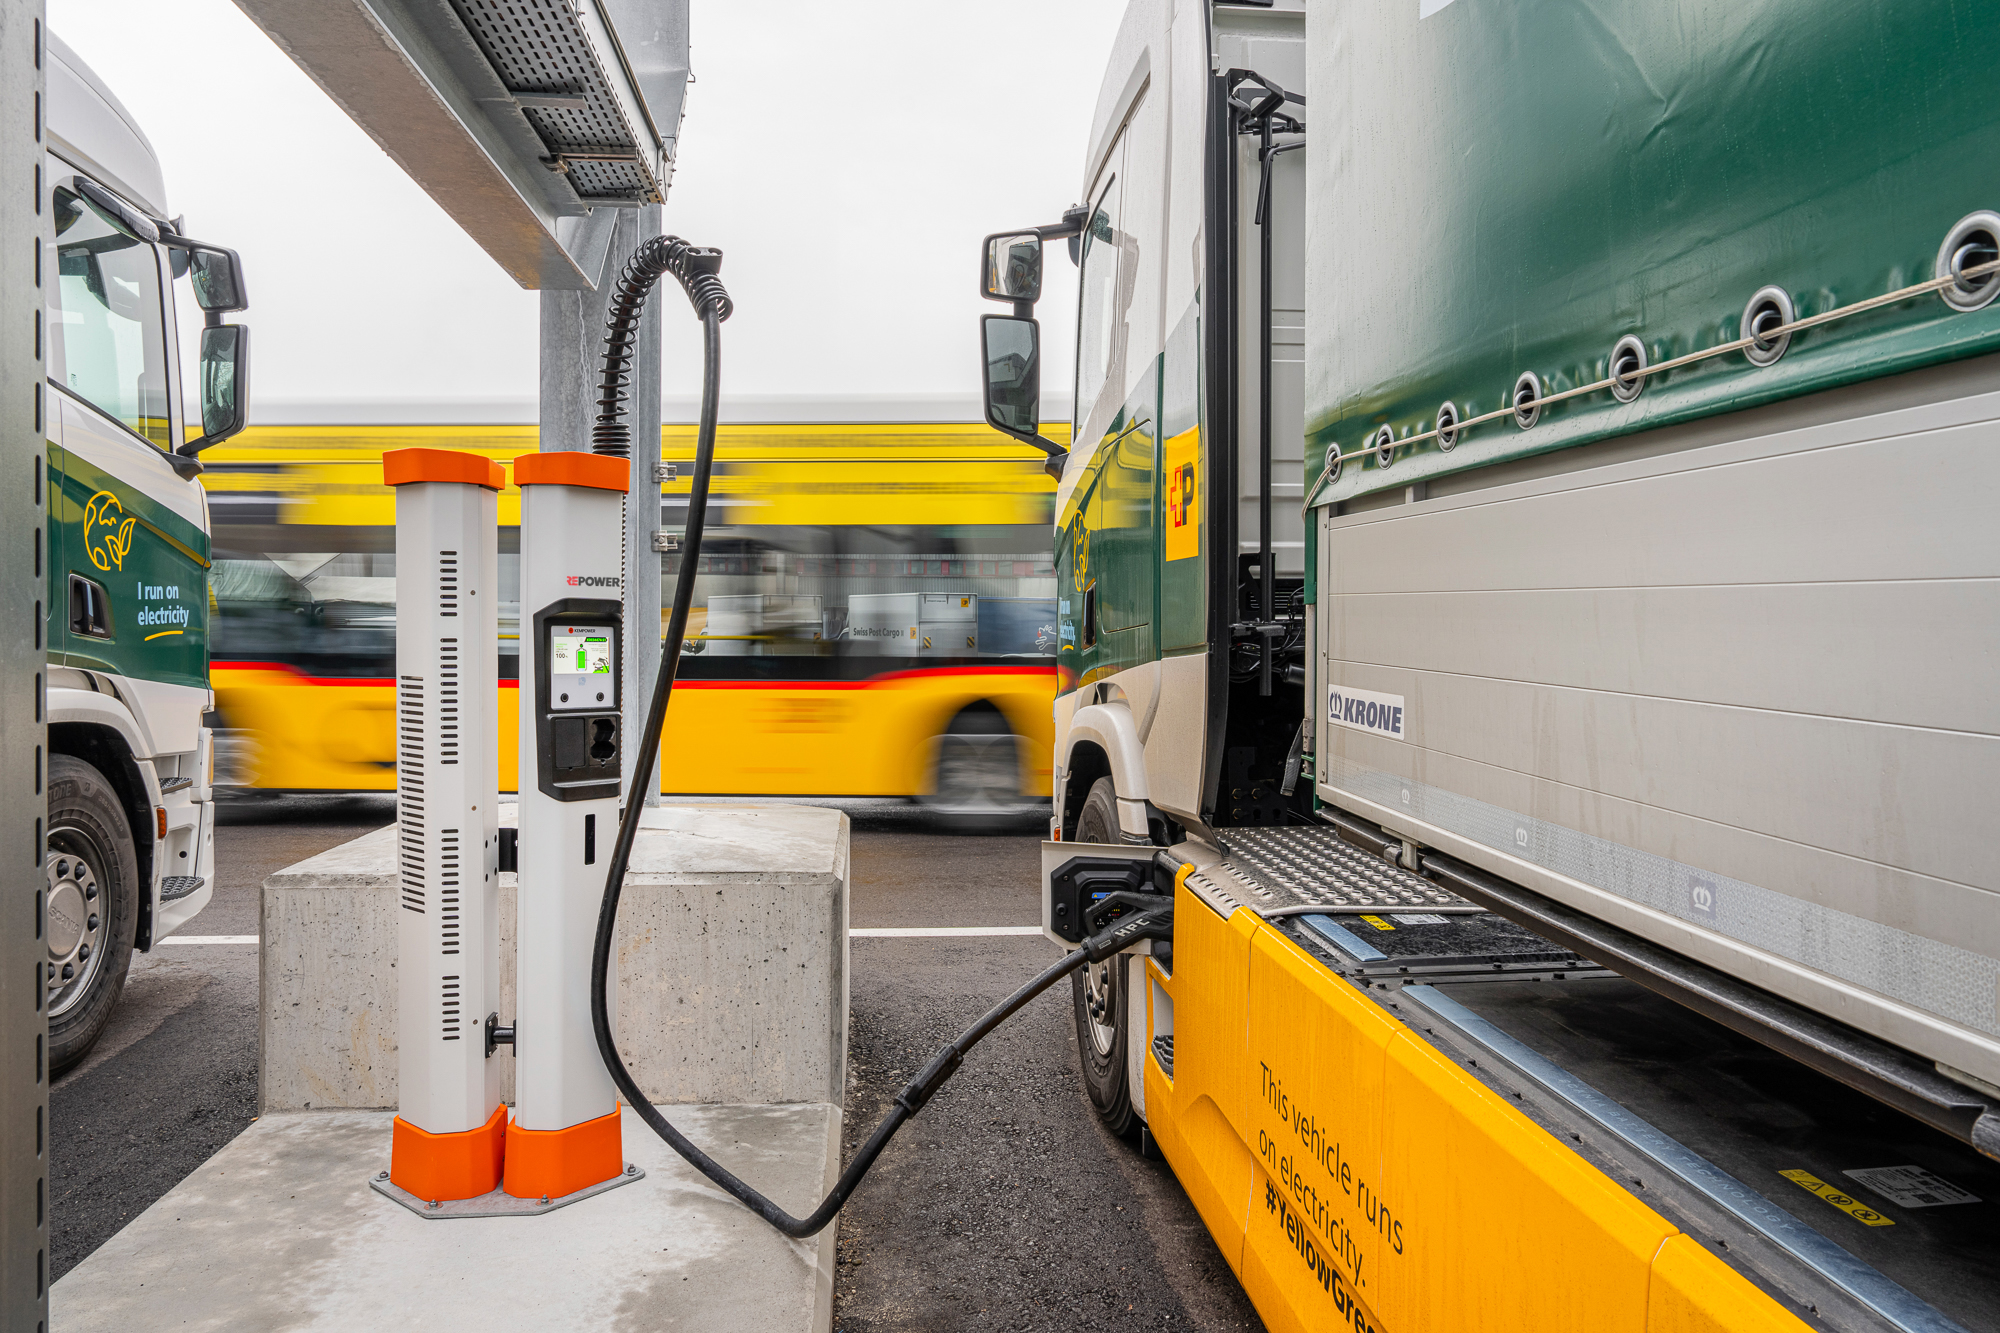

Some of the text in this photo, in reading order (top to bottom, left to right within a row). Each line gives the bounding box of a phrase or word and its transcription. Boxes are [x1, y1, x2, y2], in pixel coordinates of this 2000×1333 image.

[137, 582, 179, 600] I run on
[567, 576, 620, 587] REPOWER
[137, 605, 190, 628] electricity
[853, 627, 869, 637] Swiss
[869, 627, 882, 637] Post
[882, 628, 900, 639] Cargo
[1343, 697, 1402, 734] KRONE
[1114, 918, 1150, 937] HPC
[1260, 1061, 1403, 1255] This vehicle runs
[1607, 1111, 1673, 1151] BATTERY
[1678, 1156, 1796, 1232] TECHNOLOGY
[1259, 1129, 1366, 1288] on electricity.
